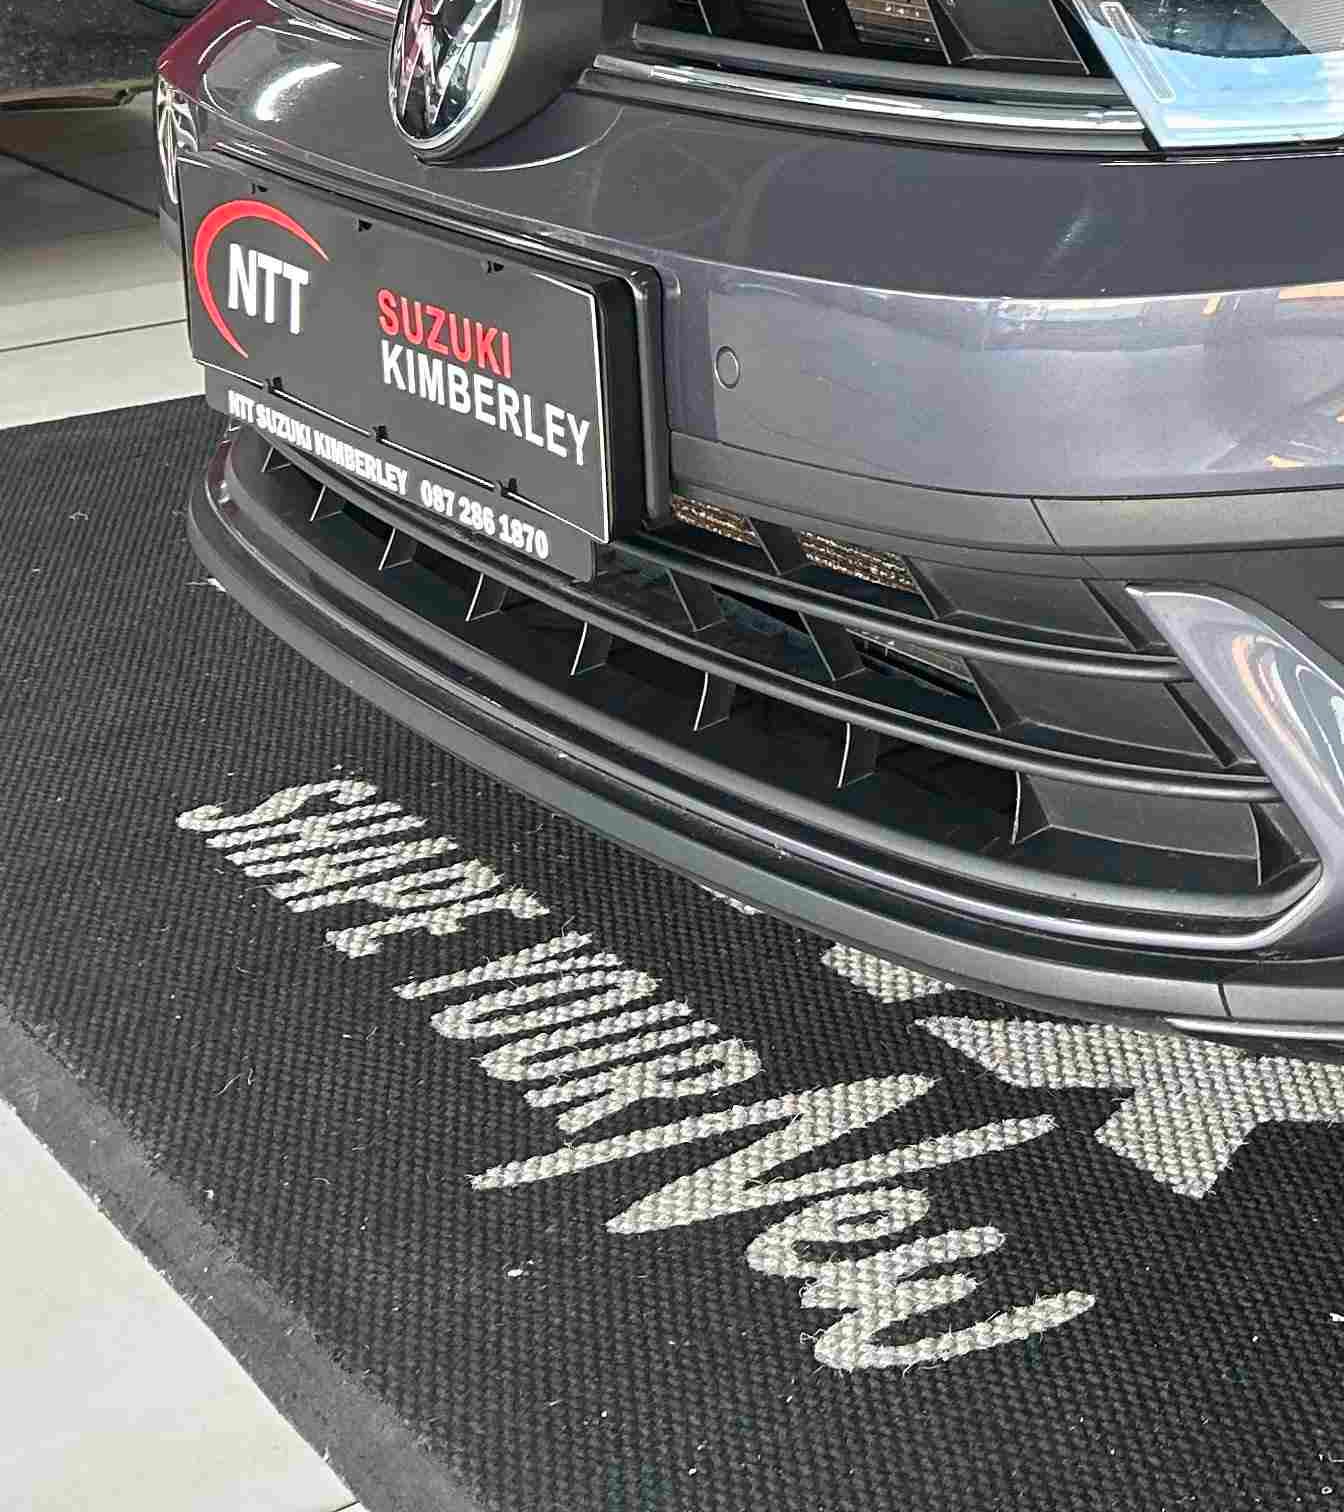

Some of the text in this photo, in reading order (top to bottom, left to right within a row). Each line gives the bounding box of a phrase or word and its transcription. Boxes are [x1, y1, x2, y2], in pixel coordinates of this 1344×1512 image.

[226, 242, 310, 336] NTT
[376, 288, 513, 379] SUZUKI
[379, 340, 591, 467] KIMBERLEY
[227, 390, 549, 560] NTT SUZUKI KIMBERLEY 087 286 1870
[393, 930, 763, 1134] YOUR
